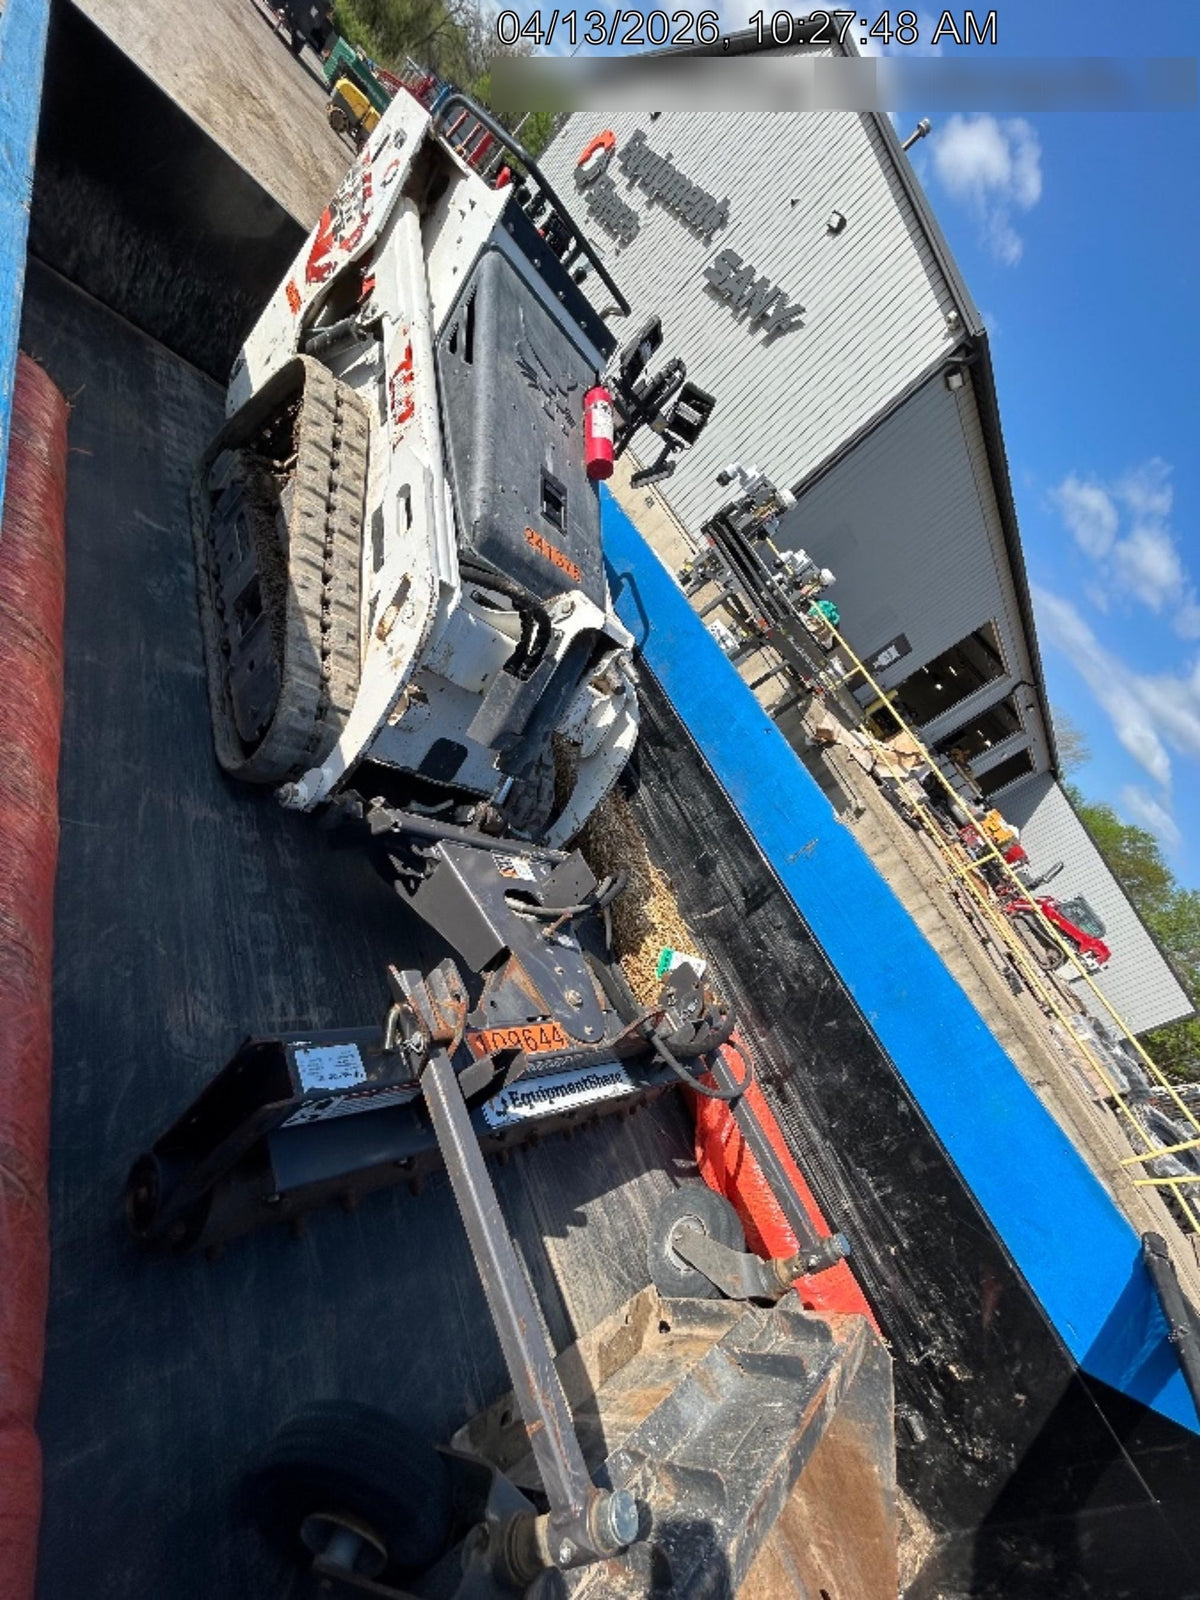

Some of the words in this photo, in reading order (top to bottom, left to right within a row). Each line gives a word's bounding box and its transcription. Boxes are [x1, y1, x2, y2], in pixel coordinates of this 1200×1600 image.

[617, 128, 731, 235] Equipment
[702, 248, 806, 333] SANY
[507, 1069, 625, 1110] EquipmentShare
